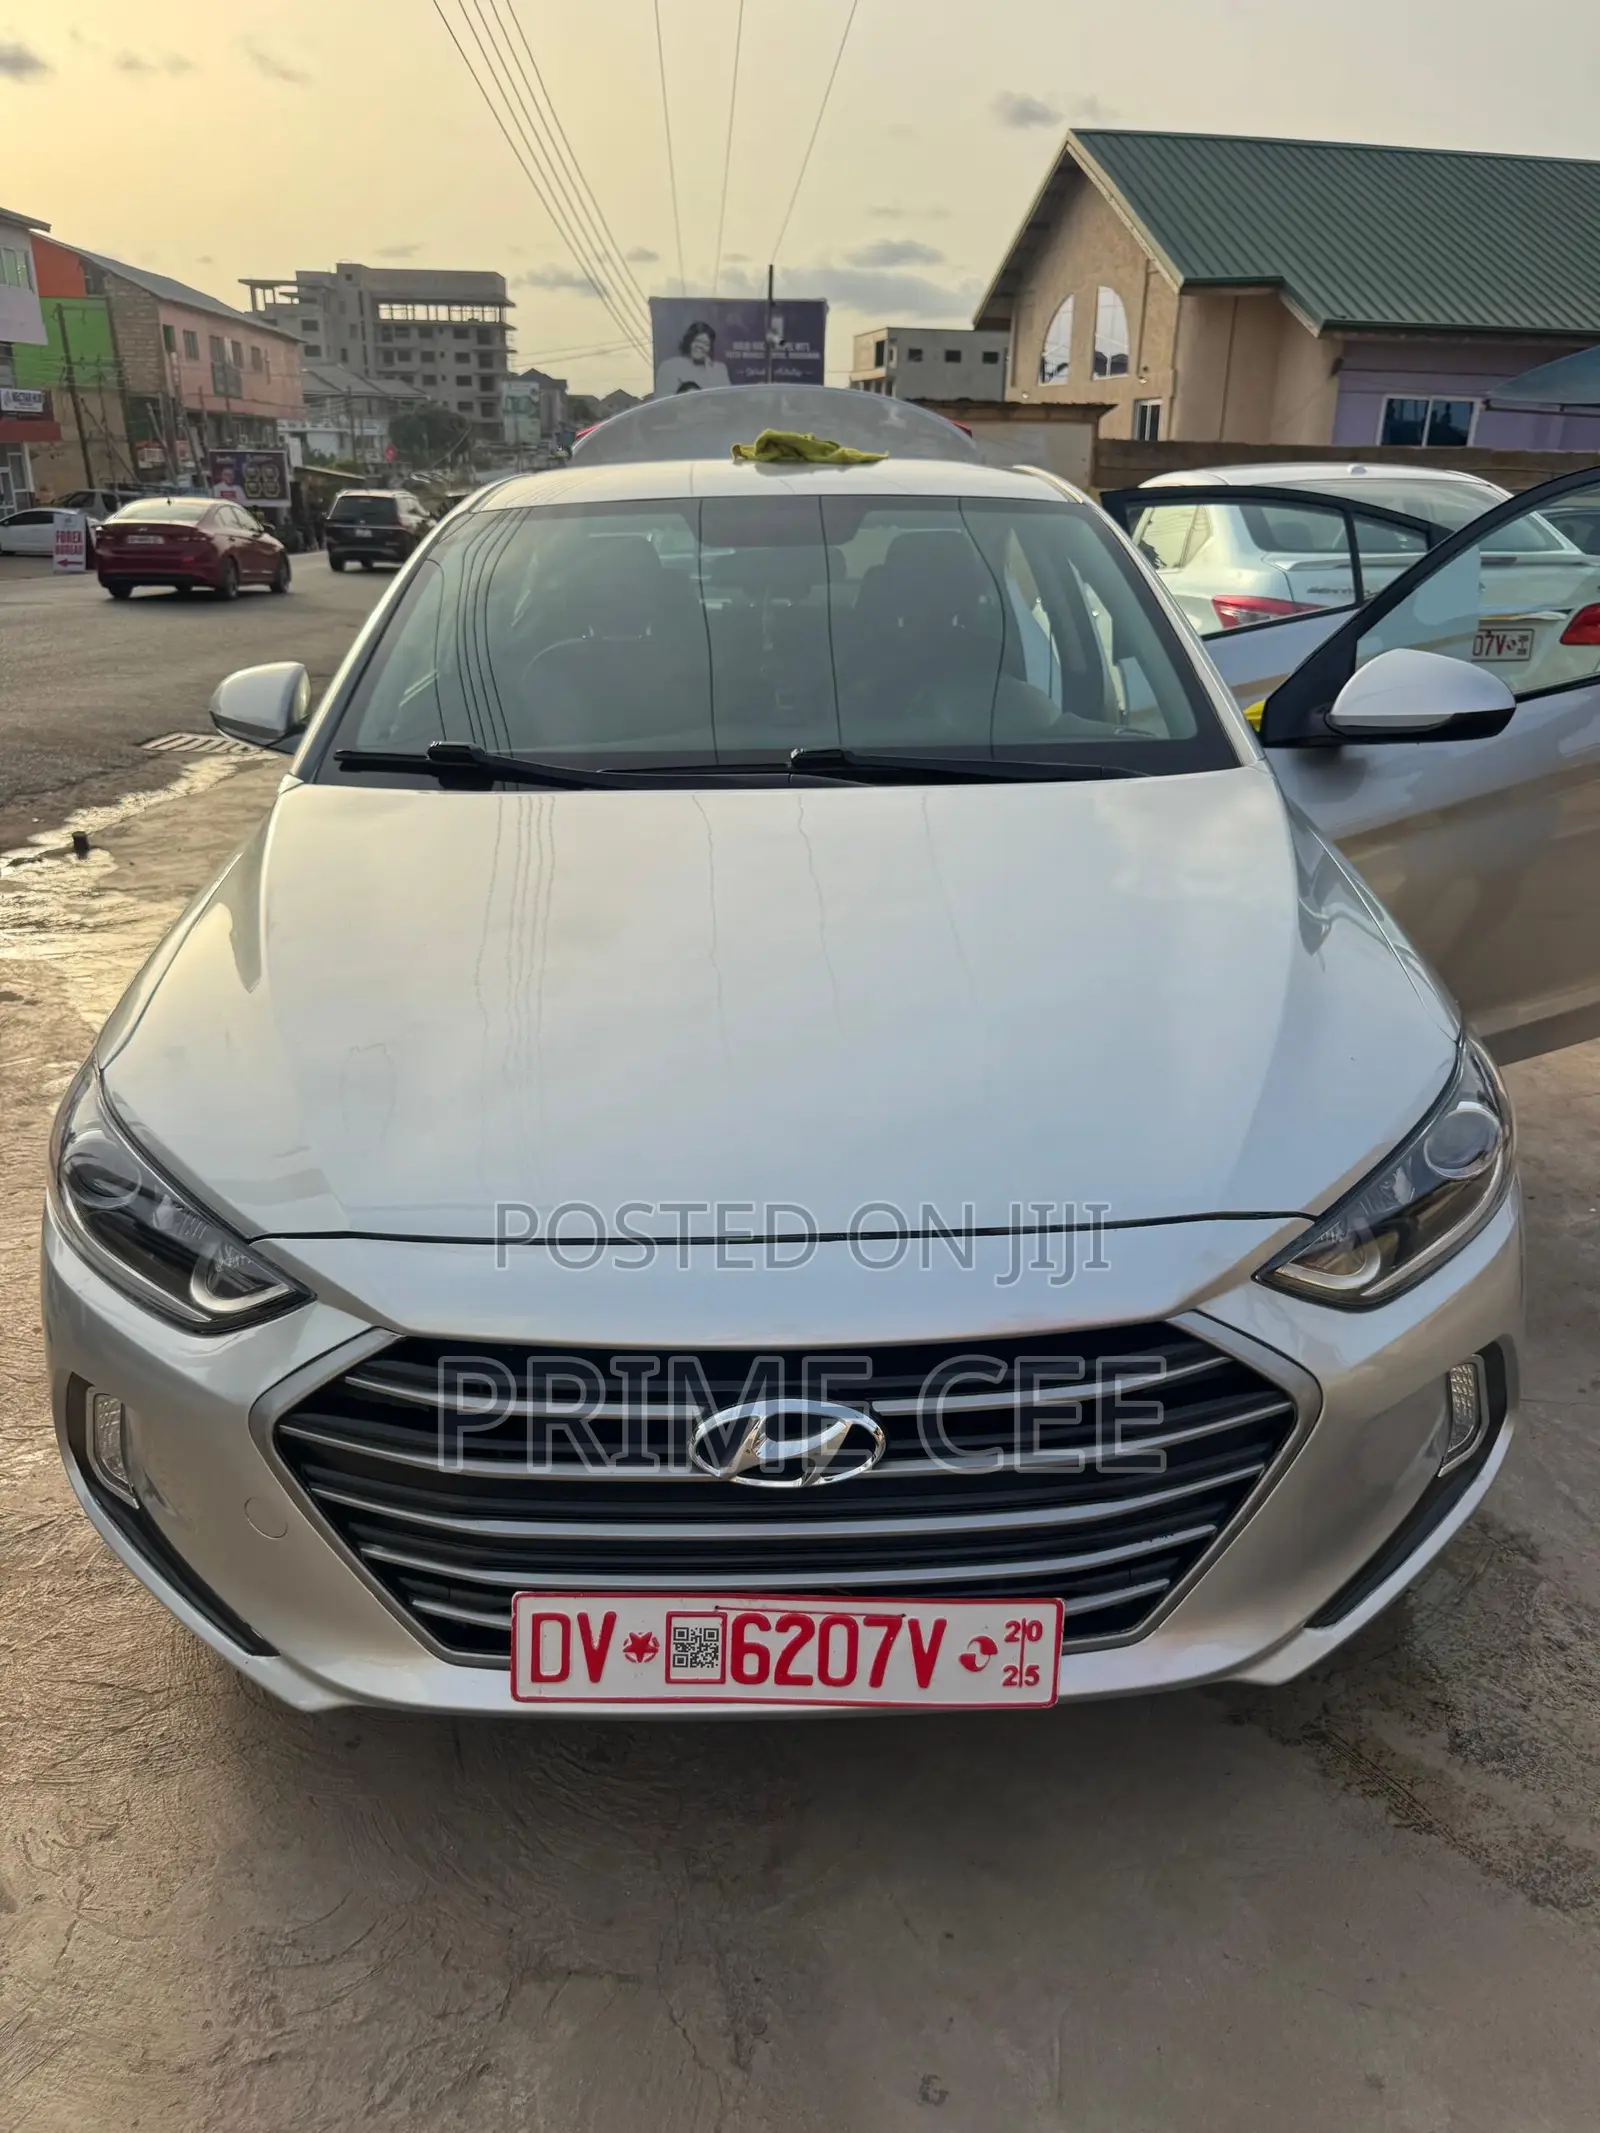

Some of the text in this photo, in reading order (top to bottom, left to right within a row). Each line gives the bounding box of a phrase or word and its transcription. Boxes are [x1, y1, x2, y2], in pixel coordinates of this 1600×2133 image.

[55, 531, 83, 543] FOREX
[1003, 1619, 1044, 1643] 20
[531, 1611, 947, 1689] DV 6207V
[1002, 1664, 1041, 1688] 25
